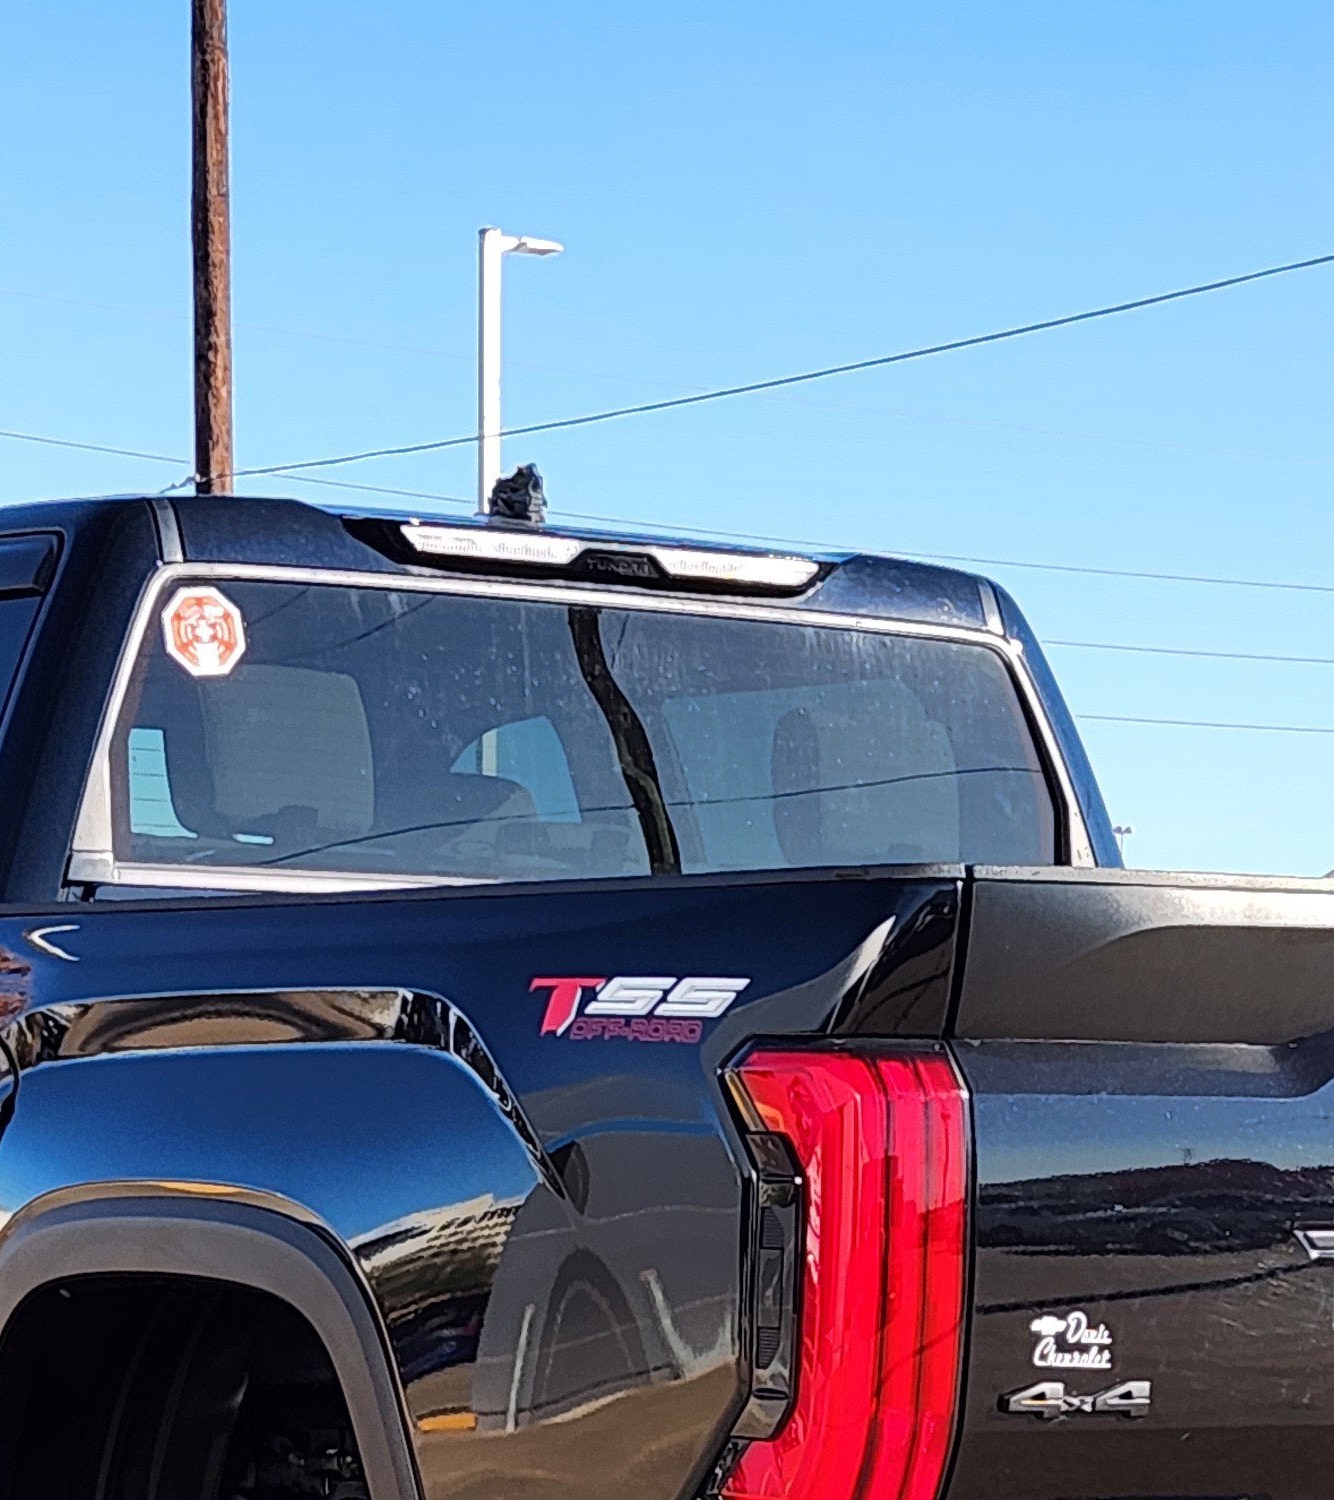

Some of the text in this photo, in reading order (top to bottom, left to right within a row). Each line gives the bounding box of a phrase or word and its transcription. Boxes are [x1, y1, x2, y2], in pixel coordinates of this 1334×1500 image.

[528, 976, 751, 1037] TSS
[570, 1017, 703, 1043] OFF-ROAD
[1033, 1337, 1112, 1368] Chevrolet
